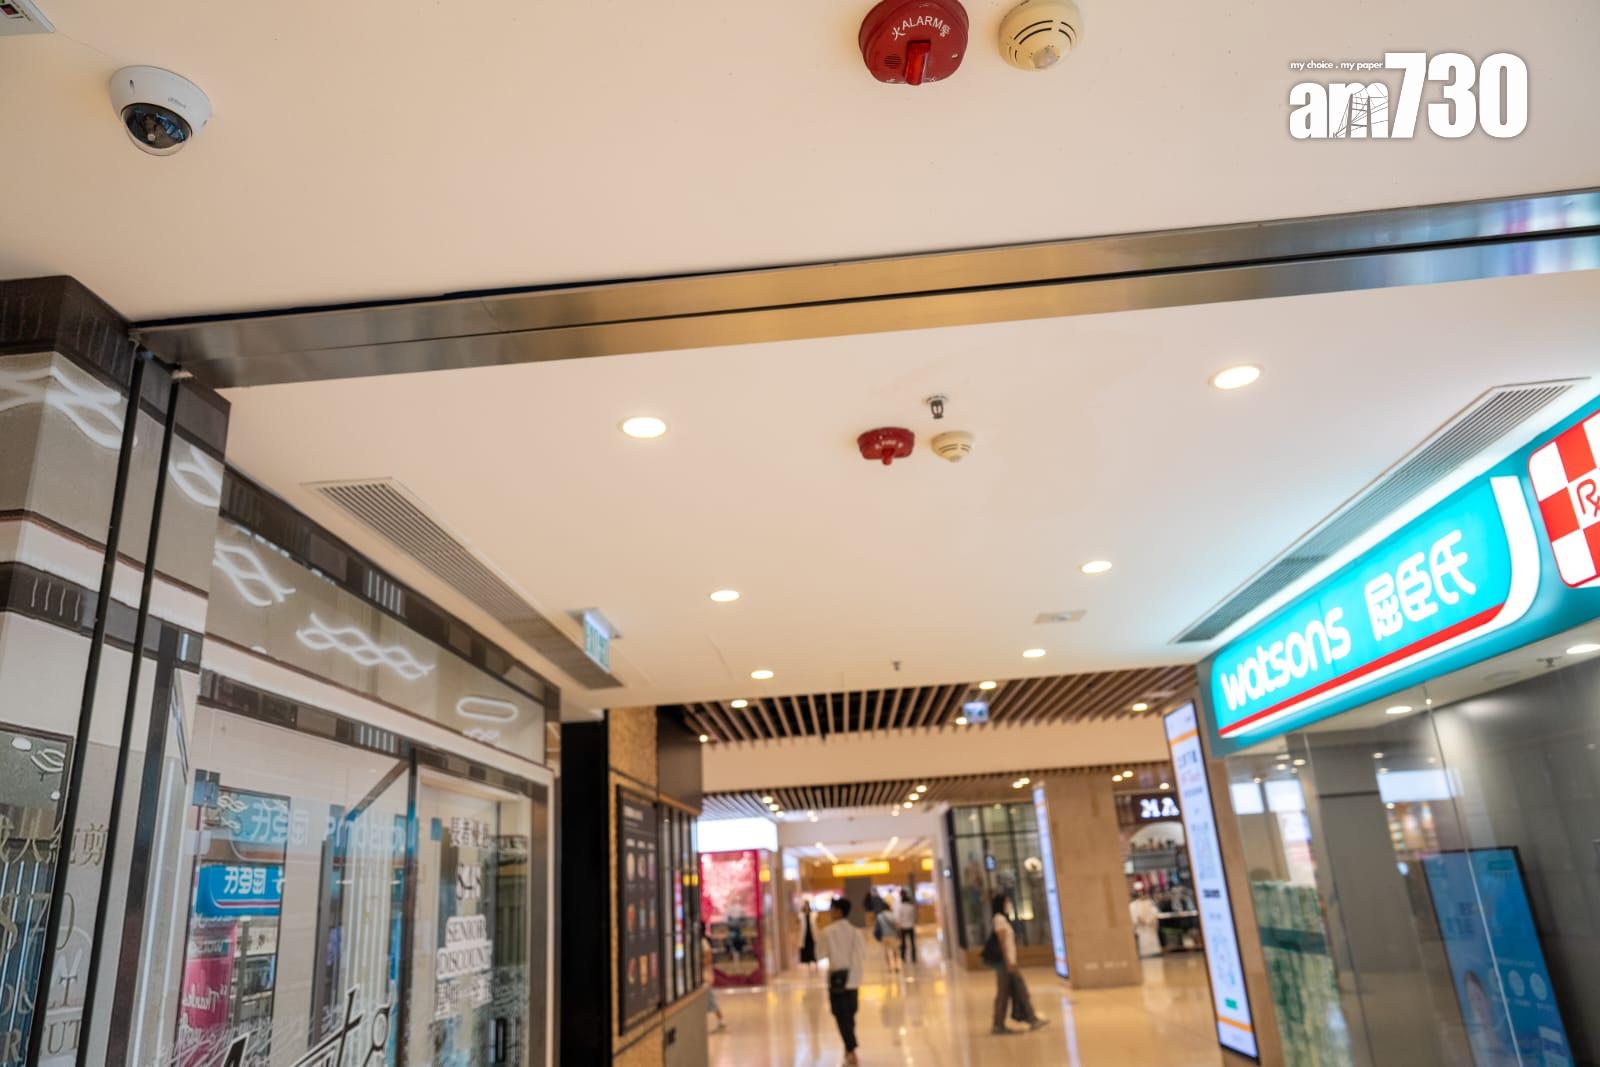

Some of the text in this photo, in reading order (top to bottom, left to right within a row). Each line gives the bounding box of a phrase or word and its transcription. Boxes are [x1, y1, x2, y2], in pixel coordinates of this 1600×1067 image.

[902, 15, 944, 31] ALARM
[1220, 528, 1477, 711] watsons 屈臣氏
[447, 918, 486, 945] SENIOR
[437, 943, 492, 978] DISCOUNT
